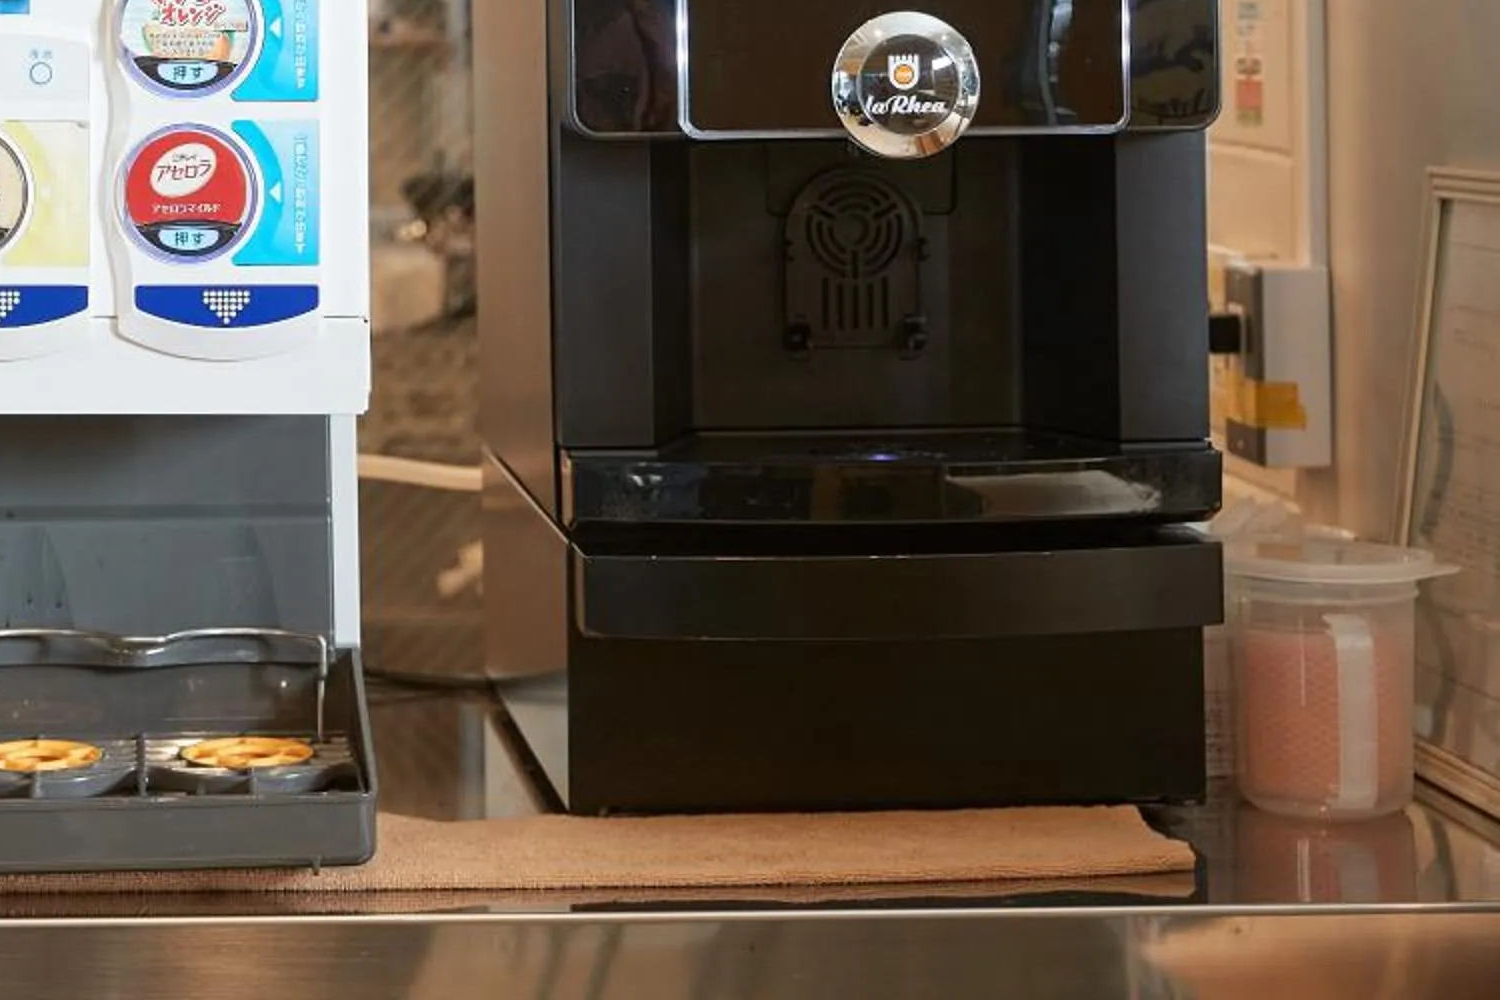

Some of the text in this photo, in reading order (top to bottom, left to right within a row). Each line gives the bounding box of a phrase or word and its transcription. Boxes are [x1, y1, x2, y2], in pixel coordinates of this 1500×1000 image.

[160, 3, 226, 26] オレンジ
[173, 65, 203, 80] 押す
[156, 159, 213, 182] アセロラ
[174, 232, 204, 246] 押す
